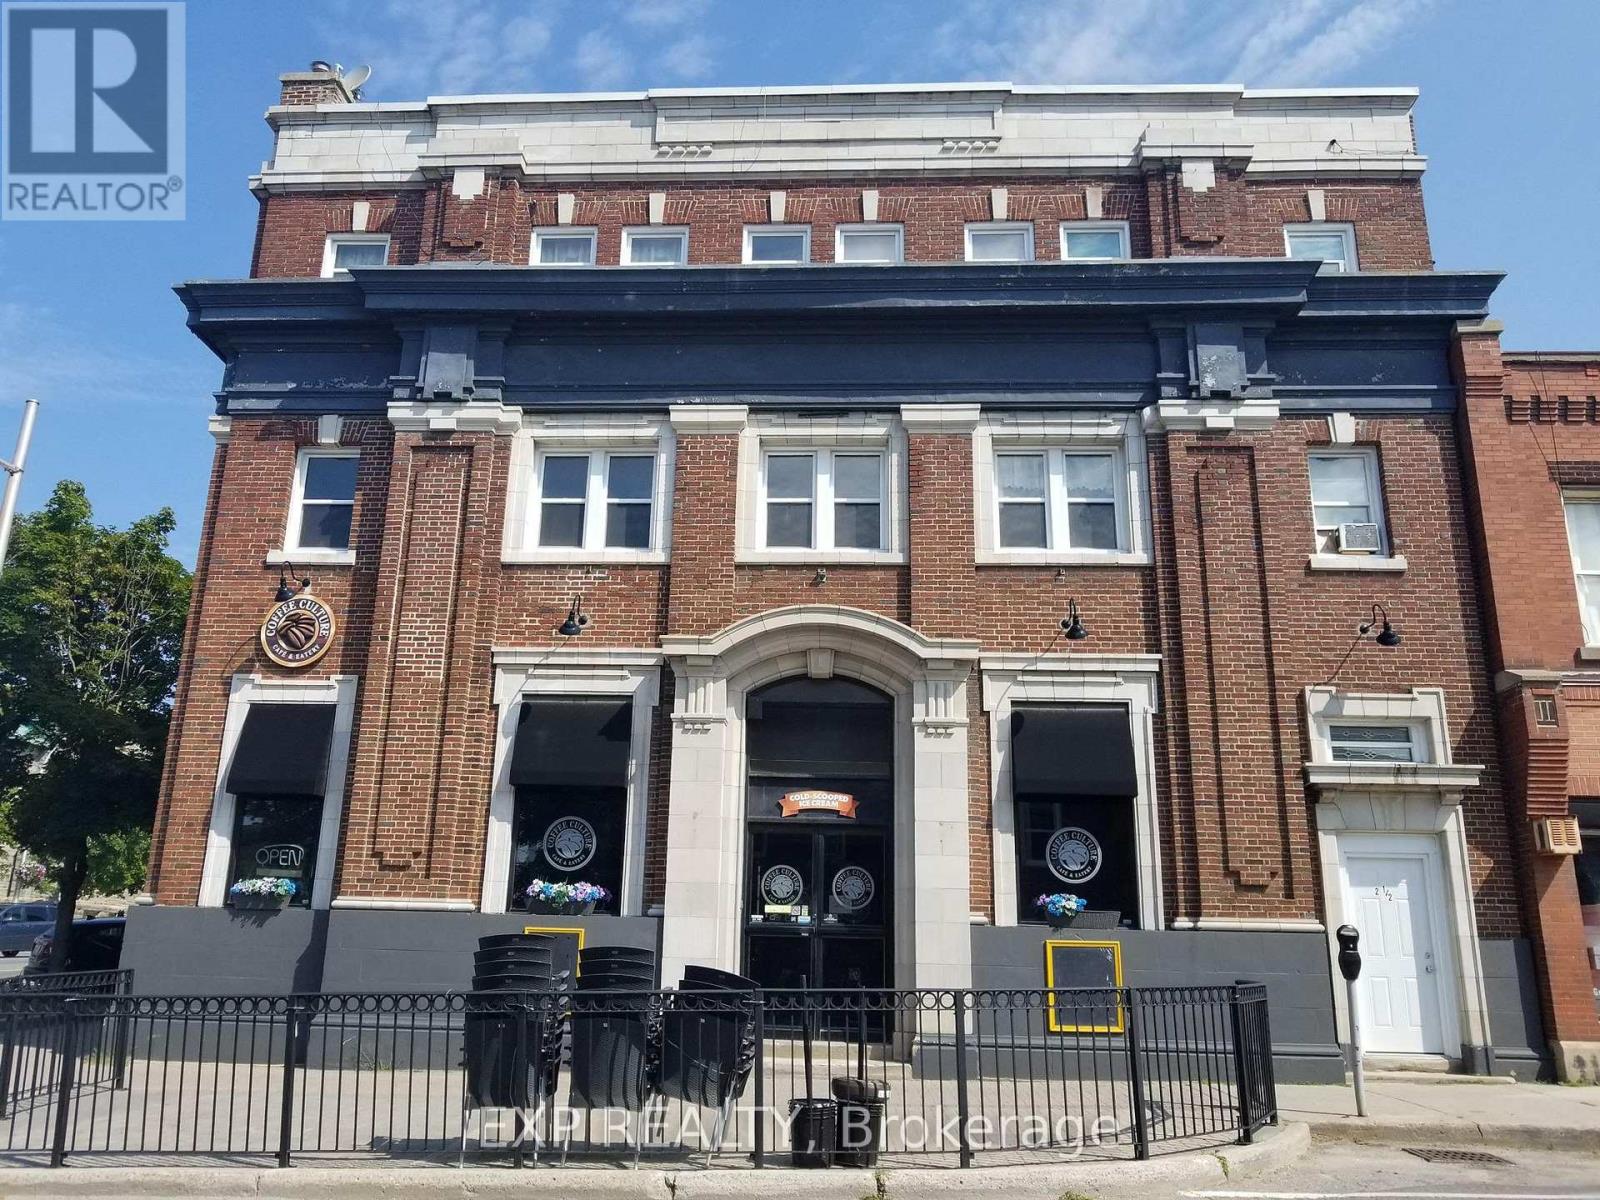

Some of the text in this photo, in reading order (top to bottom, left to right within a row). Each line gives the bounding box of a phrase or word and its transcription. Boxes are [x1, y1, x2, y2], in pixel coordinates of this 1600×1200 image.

[266, 599, 330, 638] COFFEE CULTURE
[272, 644, 287, 658] CAFÉ
[295, 644, 321, 660] EATERY
[799, 800, 839, 808] ICE CREAM
[547, 820, 592, 851] COFFEE CULTURE
[1050, 831, 1098, 862] COFFEE CULTURE
[255, 848, 302, 867] OPEN
[764, 868, 800, 891] COFFEE CULTURE
[835, 869, 872, 892] COFFEE CULTURE
